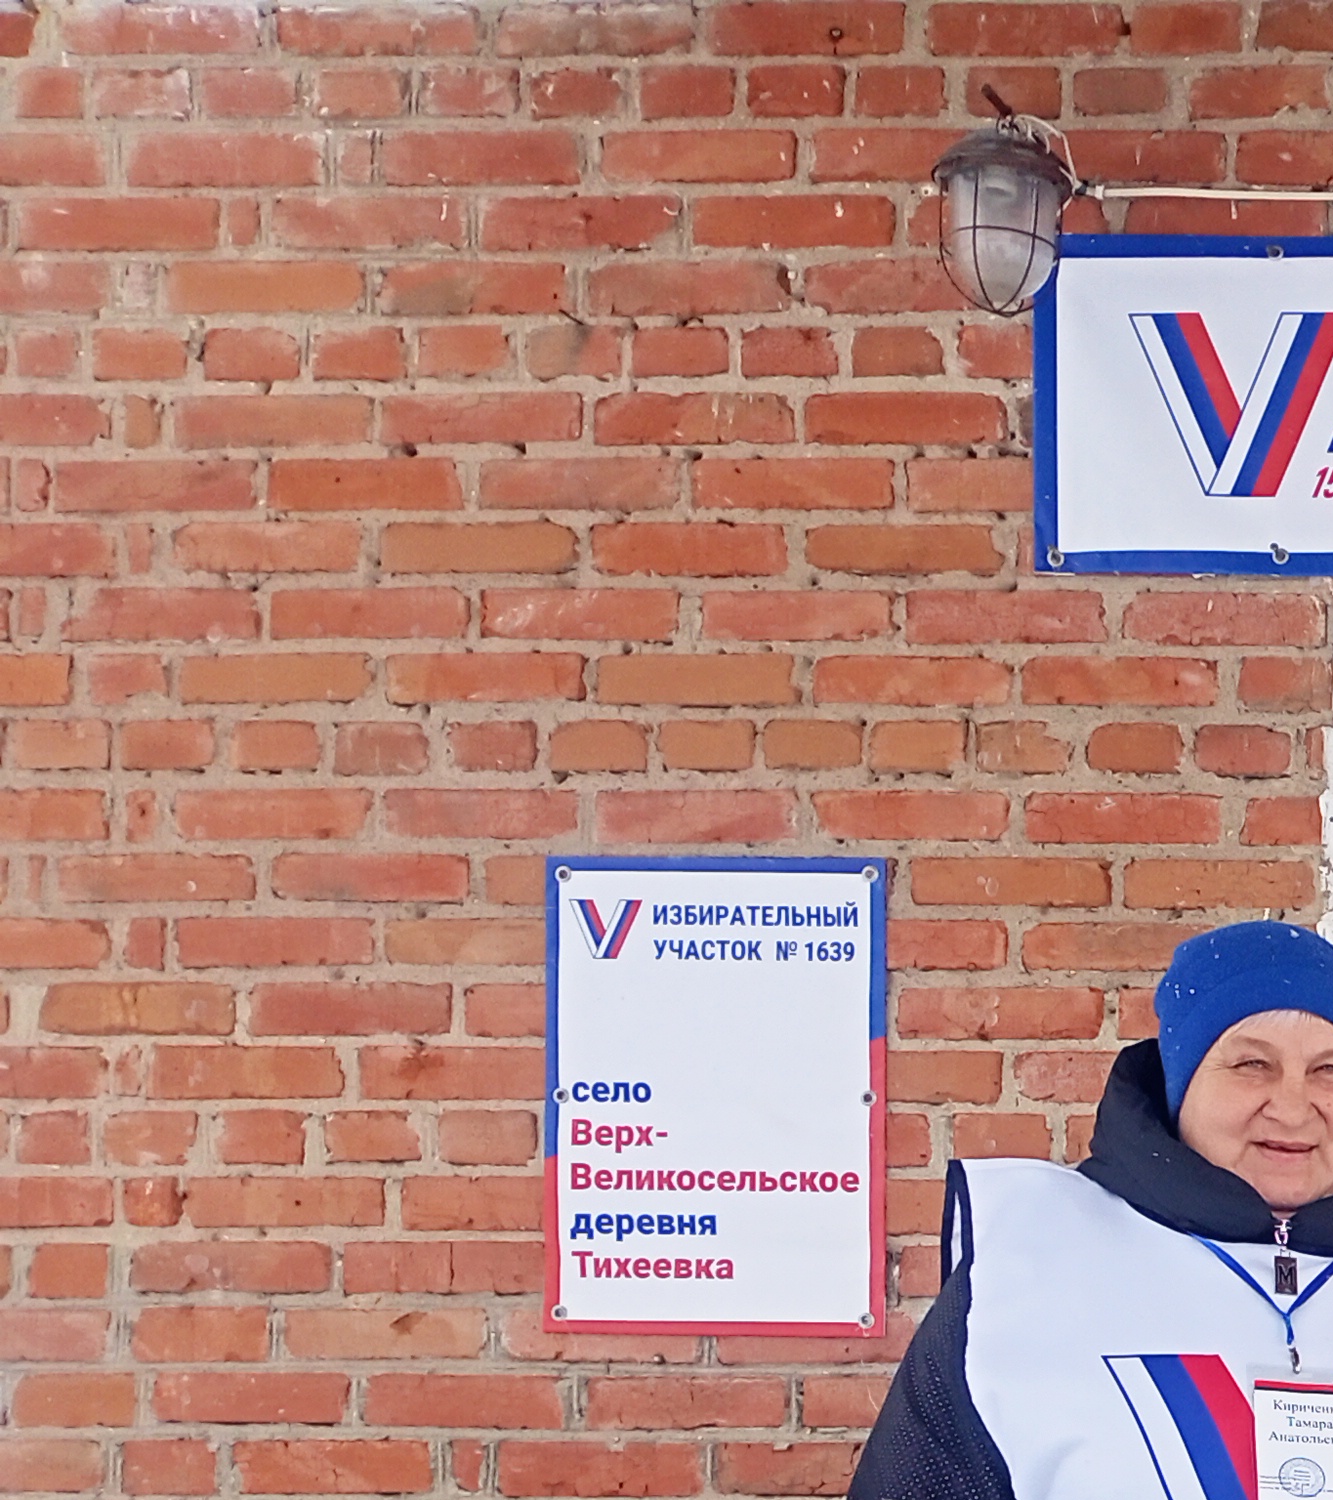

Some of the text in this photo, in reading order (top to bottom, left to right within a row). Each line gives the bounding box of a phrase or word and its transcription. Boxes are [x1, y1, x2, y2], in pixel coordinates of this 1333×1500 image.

[653, 902, 859, 928] ИЗБИРАТЕЛЬНЫЙ
[654, 940, 855, 962] УЧАСТОК № 1639
[571, 1080, 652, 1103] село
[570, 1119, 668, 1153] Верх-
[570, 1163, 860, 1193] Великосельское
[570, 1213, 718, 1241] деревня
[571, 1251, 734, 1280] Тихеевка
[1286, 1416, 1333, 1431] Тамара
